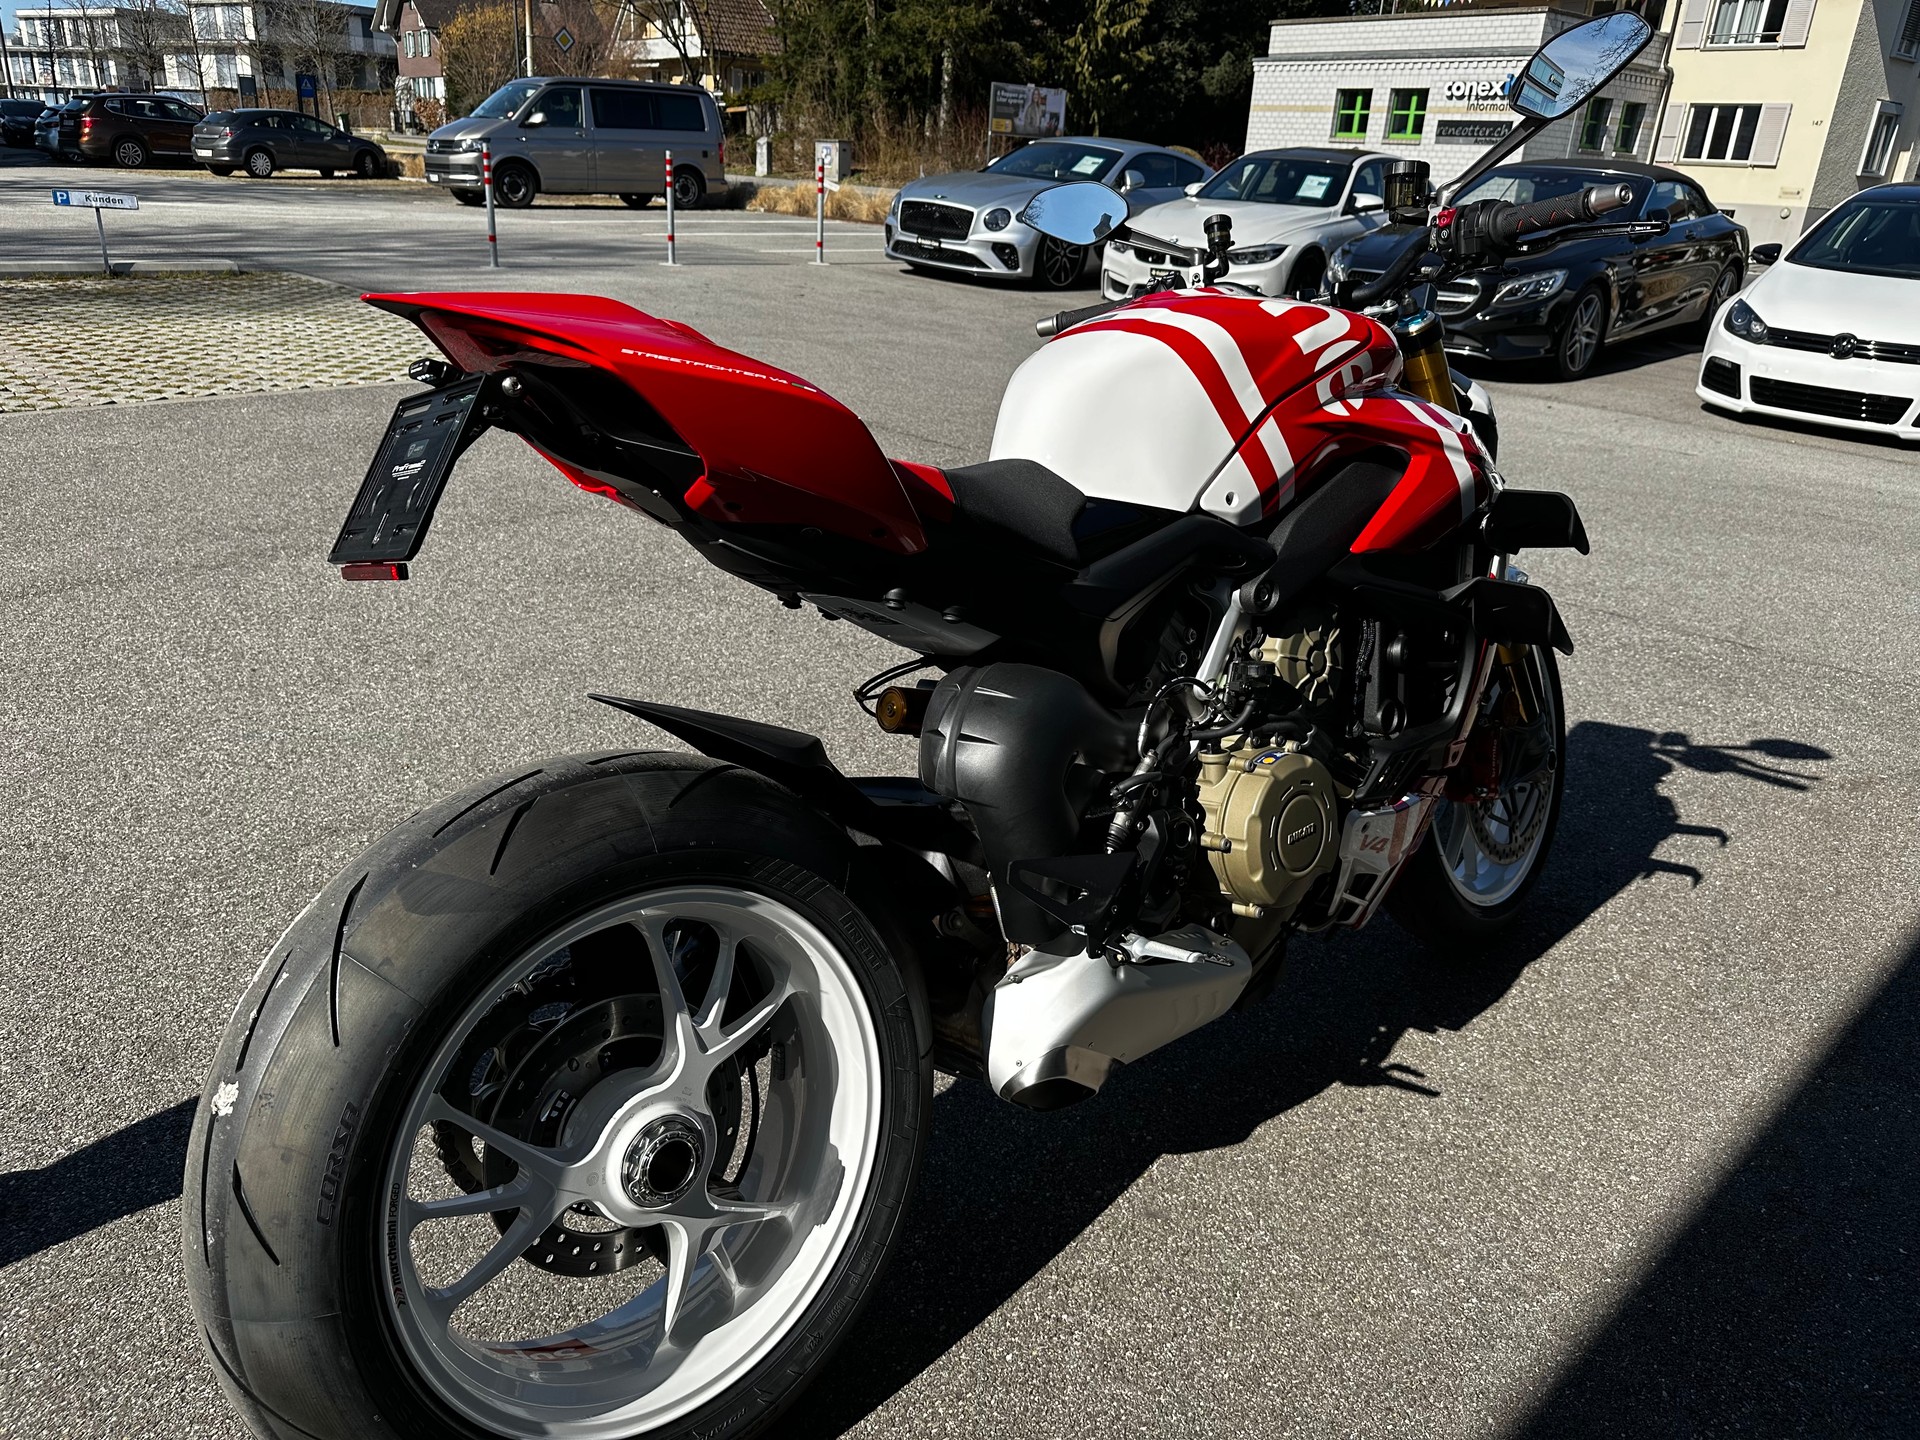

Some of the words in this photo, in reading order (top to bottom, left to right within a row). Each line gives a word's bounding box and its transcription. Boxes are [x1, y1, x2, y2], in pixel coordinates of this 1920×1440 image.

[1443, 73, 1516, 97] conexi
[1437, 123, 1509, 137] reneotter.ch
[85, 194, 124, 205] Kunden
[621, 348, 767, 379] STREETFIGHTER
[1287, 823, 1316, 845] DUCATI
[1360, 834, 1390, 854] V4
[316, 1101, 360, 1227] CORSA
[388, 1182, 400, 1219] FORGED
[387, 1220, 402, 1286] marchesini
